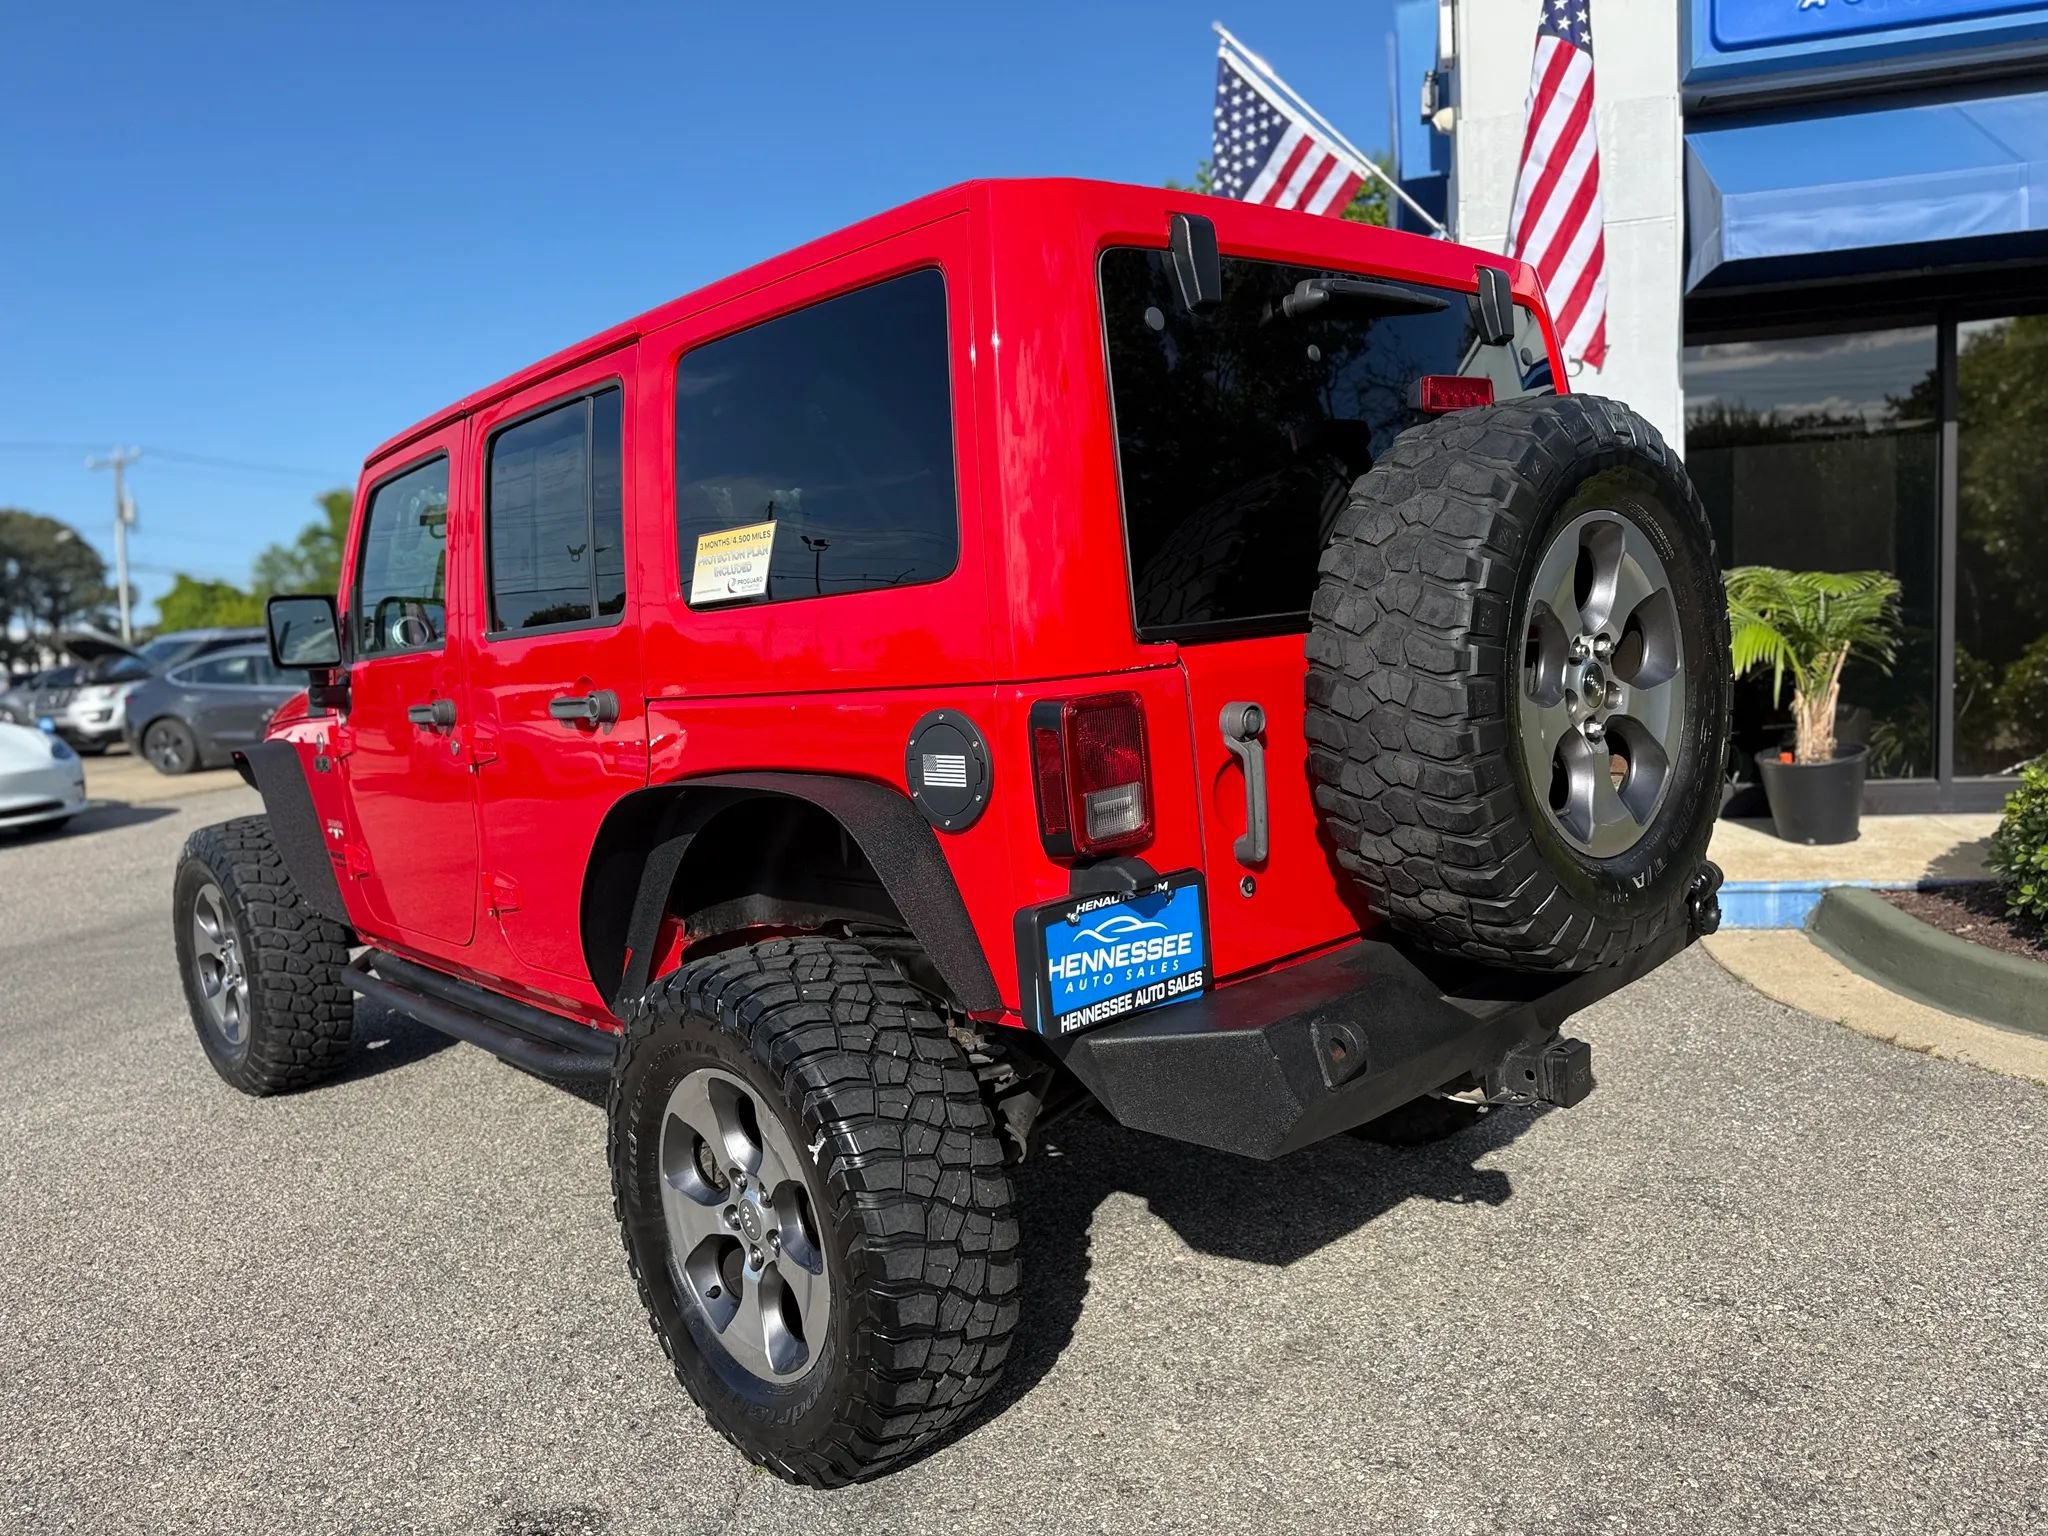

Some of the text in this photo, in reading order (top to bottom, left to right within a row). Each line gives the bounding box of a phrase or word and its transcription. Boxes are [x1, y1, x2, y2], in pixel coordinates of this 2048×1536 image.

[751, 529, 771, 541] MILES
[697, 545, 769, 566] PROTECTION PLAN
[713, 561, 752, 577] INCLUDED
[1076, 881, 1168, 913] HENAUM
[1049, 932, 1193, 981] HENNESSEE
[1065, 959, 1180, 995] AUTO SALES
[1060, 970, 1203, 1034] HENNESSEE AUTO SALES
